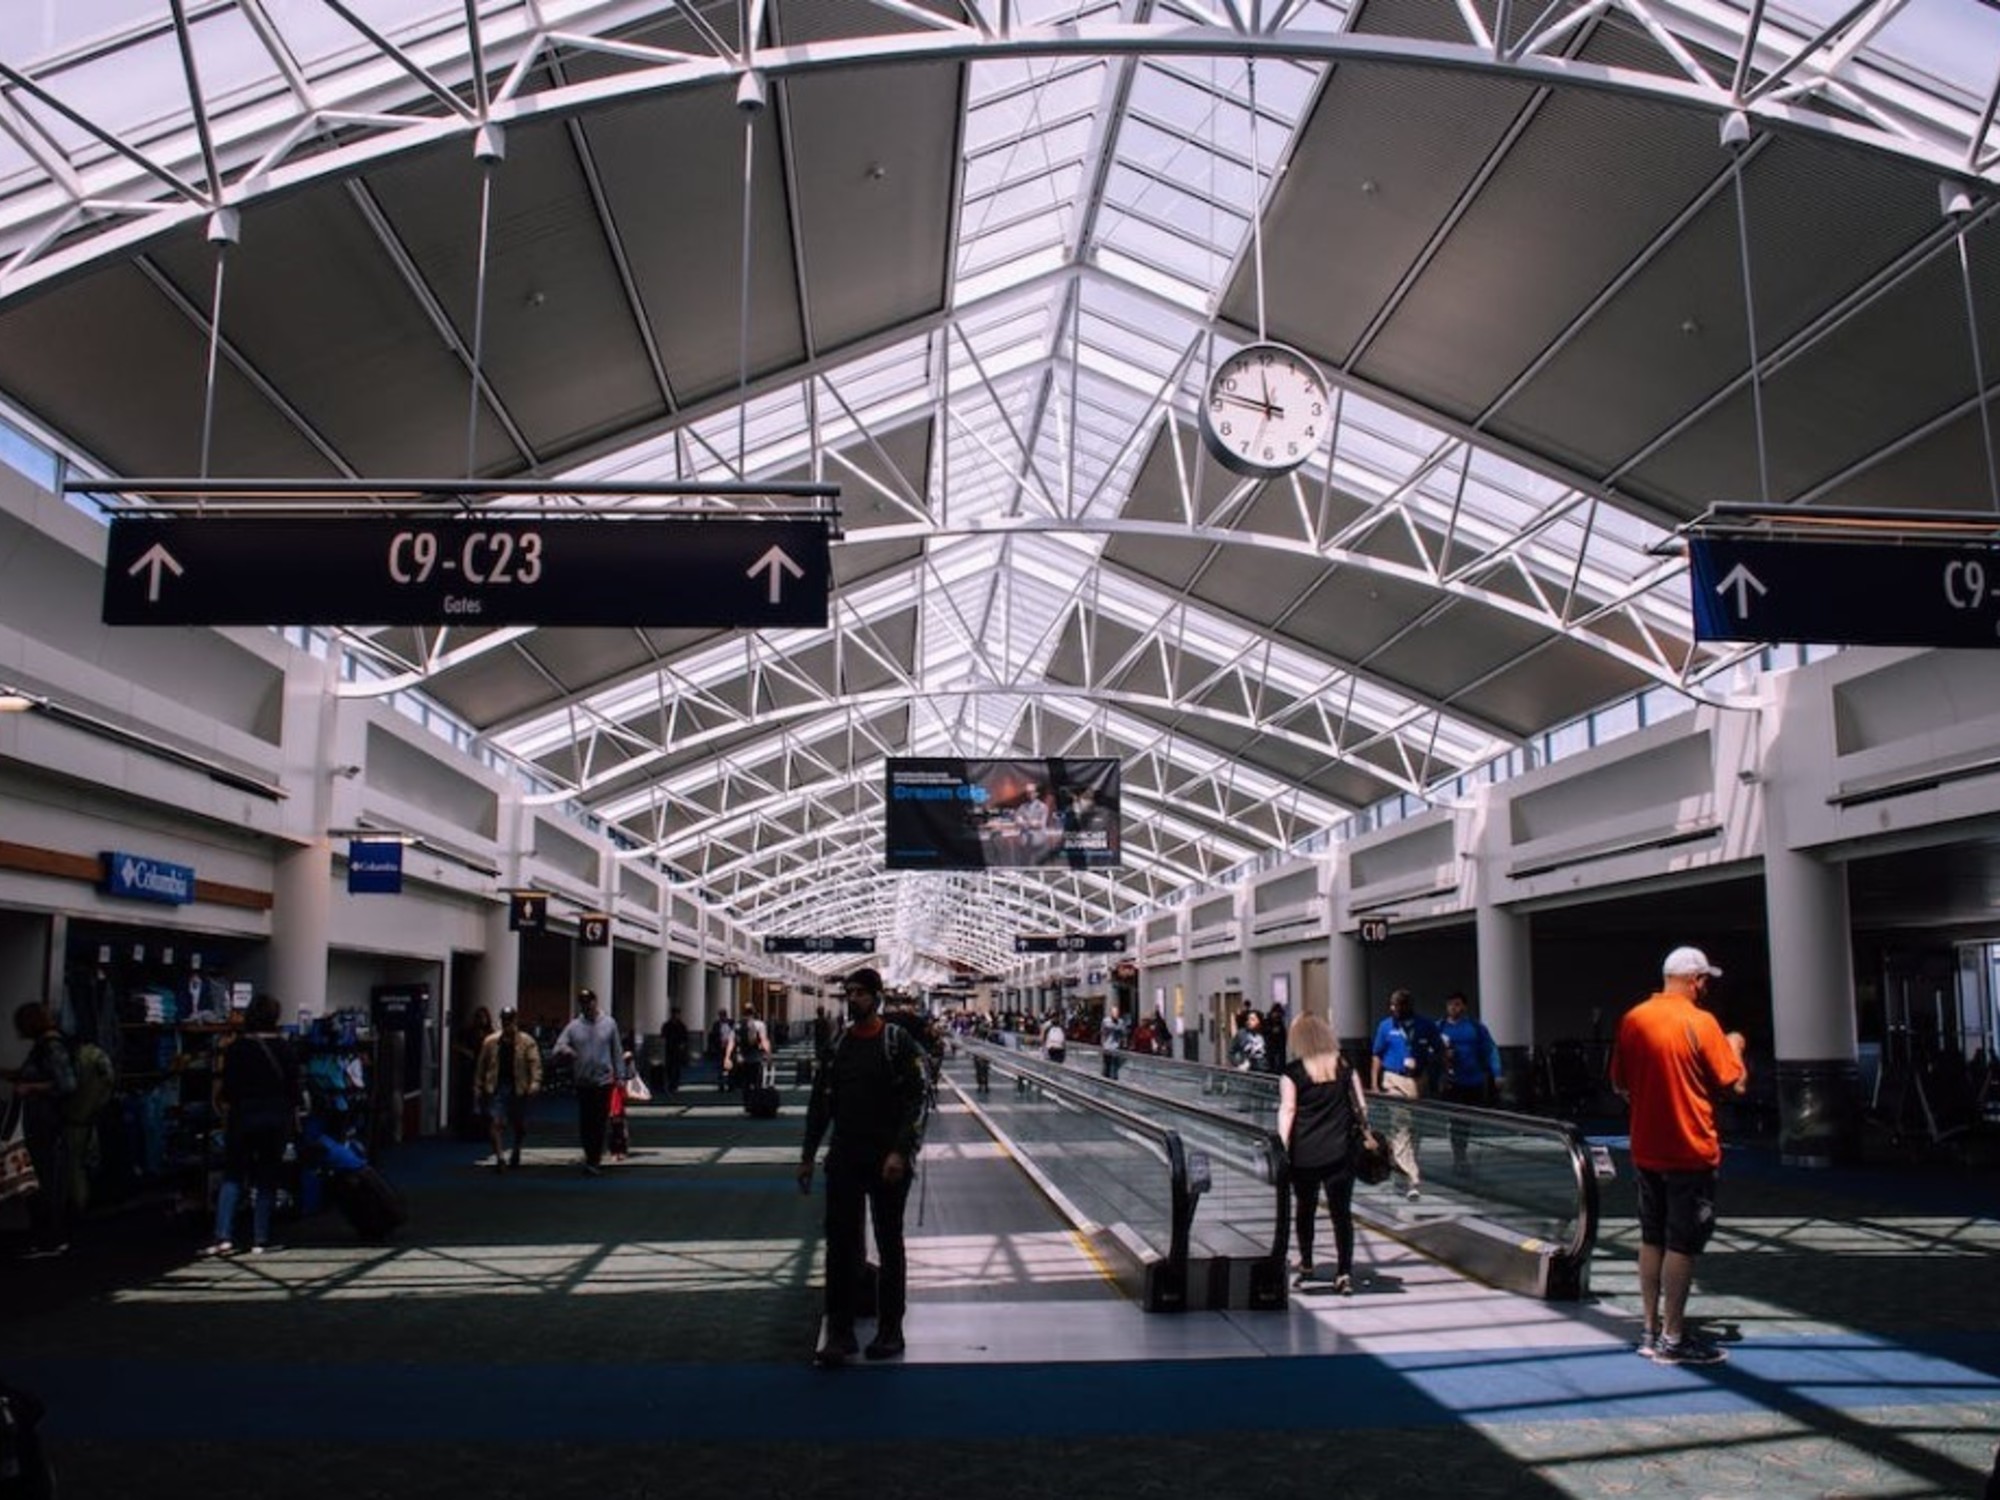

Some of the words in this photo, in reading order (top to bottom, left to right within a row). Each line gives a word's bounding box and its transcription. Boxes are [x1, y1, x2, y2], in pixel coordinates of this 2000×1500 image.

[1219, 379, 1237, 393] 10
[1304, 379, 1315, 394] 2
[1311, 402, 1322, 417] 3
[1220, 421, 1232, 436] 8
[1304, 425, 1315, 438] 4
[1239, 441, 1250, 454] 7
[1263, 446, 1274, 461] 6
[1287, 441, 1298, 456] 5
[389, 532, 542, 584] C9-C23
[443, 595, 482, 614] Gates
[359, 860, 399, 873] Columbia
[135, 861, 187, 897] Columbia
[1363, 922, 1387, 941] C10
